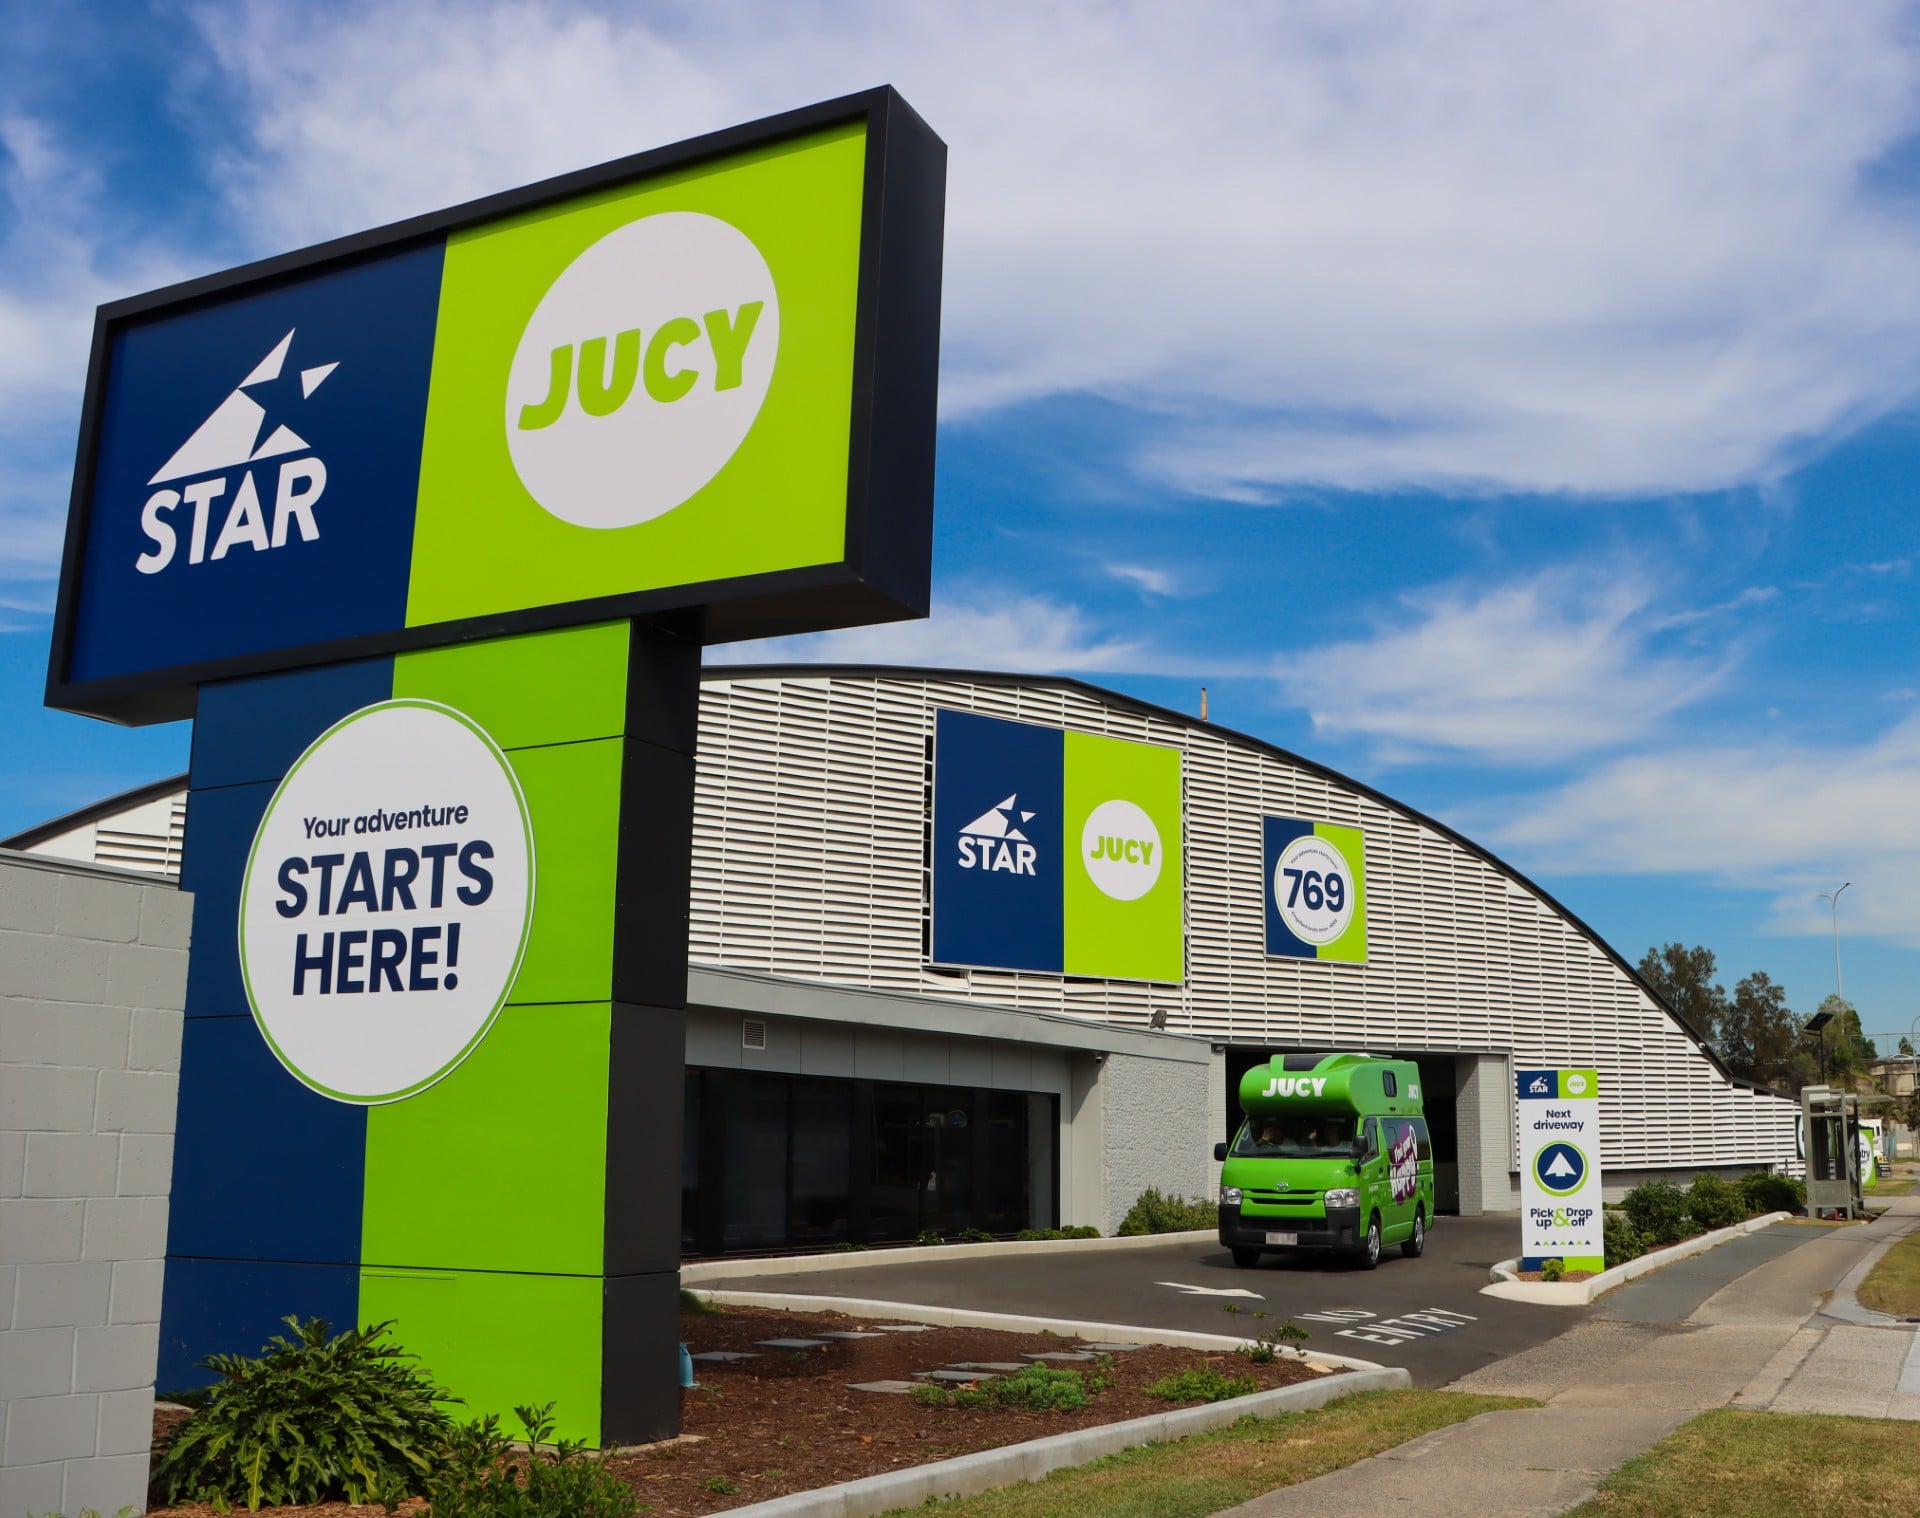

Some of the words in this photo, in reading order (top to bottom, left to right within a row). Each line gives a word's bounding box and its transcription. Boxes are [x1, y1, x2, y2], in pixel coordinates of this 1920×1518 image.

[517, 301, 764, 430] JUCY
[135, 456, 327, 574] STAR
[304, 815, 350, 839] Your
[353, 804, 469, 834] adventure
[958, 836, 1037, 876] STAR
[1090, 835, 1154, 866] JUCY
[275, 839, 495, 918] STARTS
[1283, 867, 1345, 913] 769
[292, 922, 461, 996] HERE!
[1262, 1077, 1327, 1097] JUCY
[1529, 1085, 1549, 1094] STAR
[1533, 1119, 1585, 1132] driveway
[1546, 1109, 1572, 1119] Next
[1530, 1207, 1554, 1218] Pick
[1553, 1207, 1570, 1228] &
[1566, 1207, 1593, 1220] Drop
[1536, 1218, 1553, 1230] up
[1571, 1216, 1586, 1227] off
[1294, 1309, 1377, 1324] NO
[1334, 1307, 1479, 1346] ENTRY
